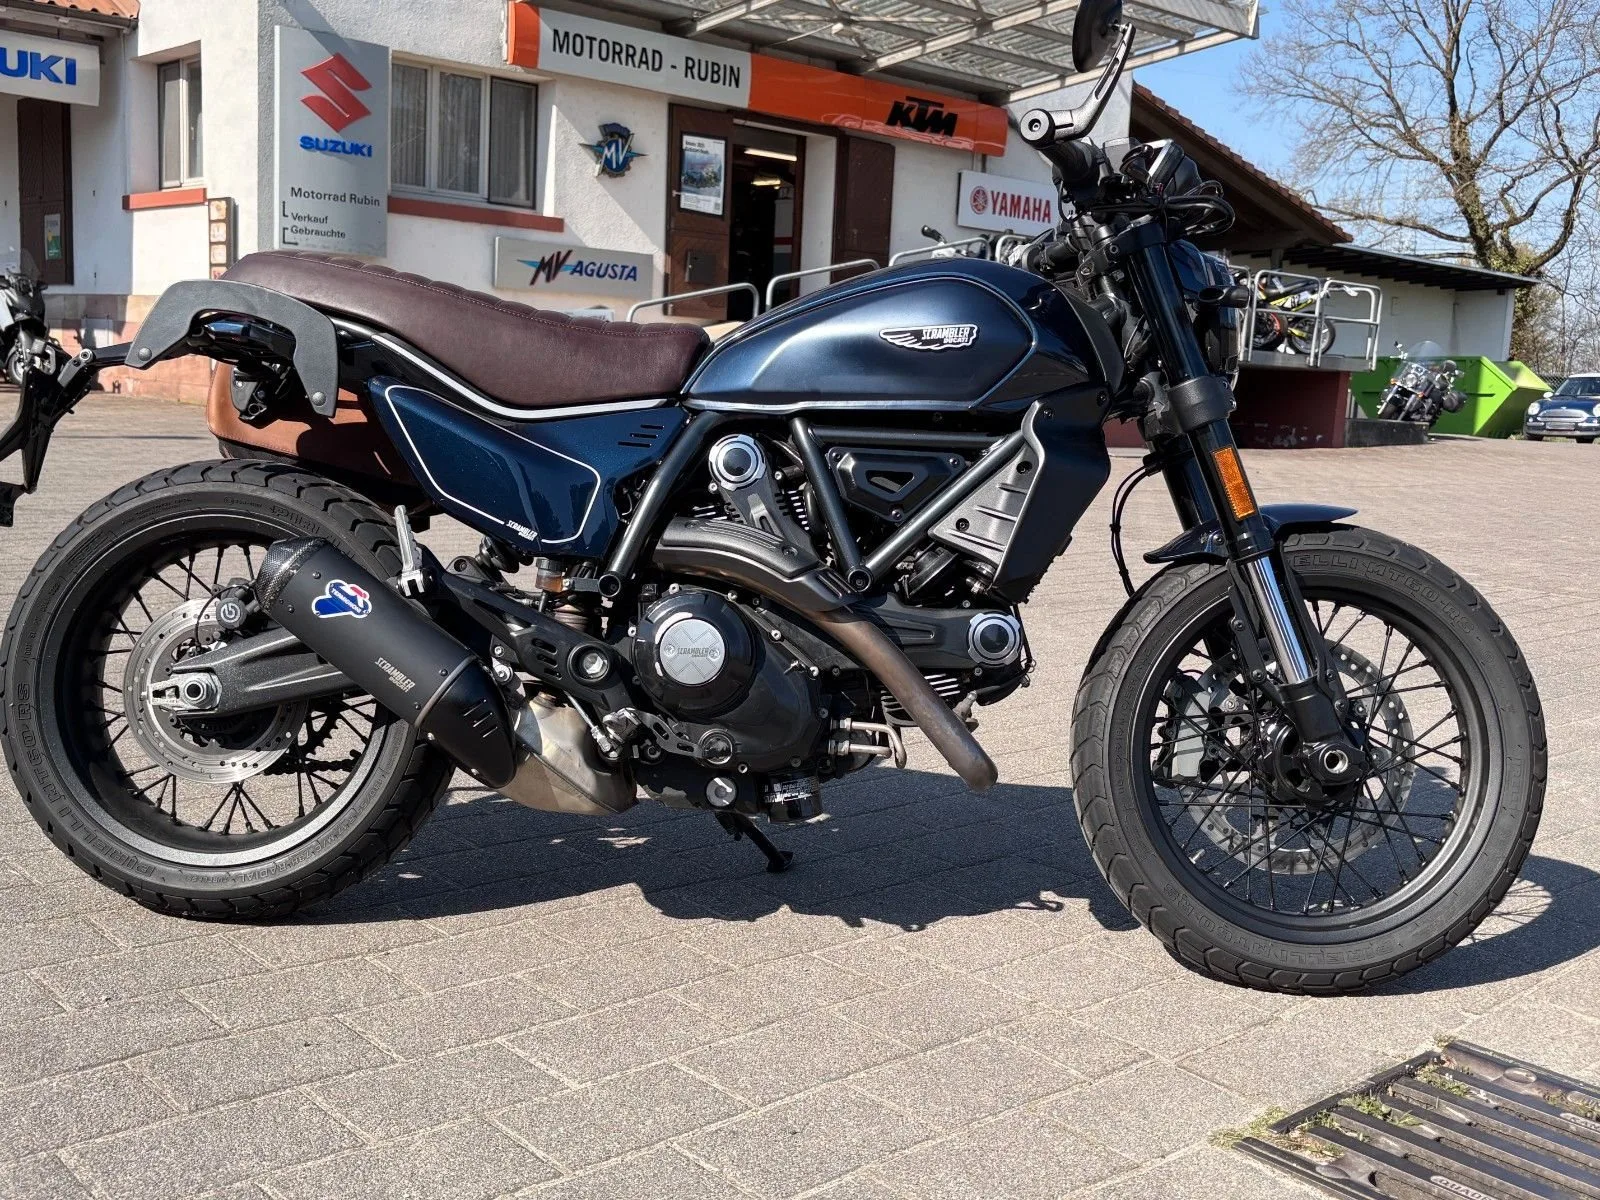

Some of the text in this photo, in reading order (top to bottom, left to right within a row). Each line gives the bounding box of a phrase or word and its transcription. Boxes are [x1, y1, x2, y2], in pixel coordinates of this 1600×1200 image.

[0, 46, 77, 86] UKI
[552, 28, 664, 72] MOTORRAD
[683, 56, 740, 88] RUBIN
[885, 95, 959, 138] KTM
[299, 135, 373, 158] SUZUKI
[291, 186, 380, 207] Motorrad Rubin
[990, 190, 1051, 224] YAMAHA
[291, 212, 329, 224] Verkauf
[290, 225, 347, 239] Gebrauchte
[530, 249, 638, 286] MV AGUSTA
[921, 327, 970, 340] SCRAMBLER
[943, 336, 969, 344] DUCATI
[505, 519, 538, 539] SCRAMBLER
[1289, 553, 1358, 570] ELLI
[330, 587, 363, 613] TERMIGNONI
[677, 646, 710, 656] SCRAMBLER
[374, 656, 416, 690] SCRAMBLER
[59, 806, 159, 877] PIRELLI
